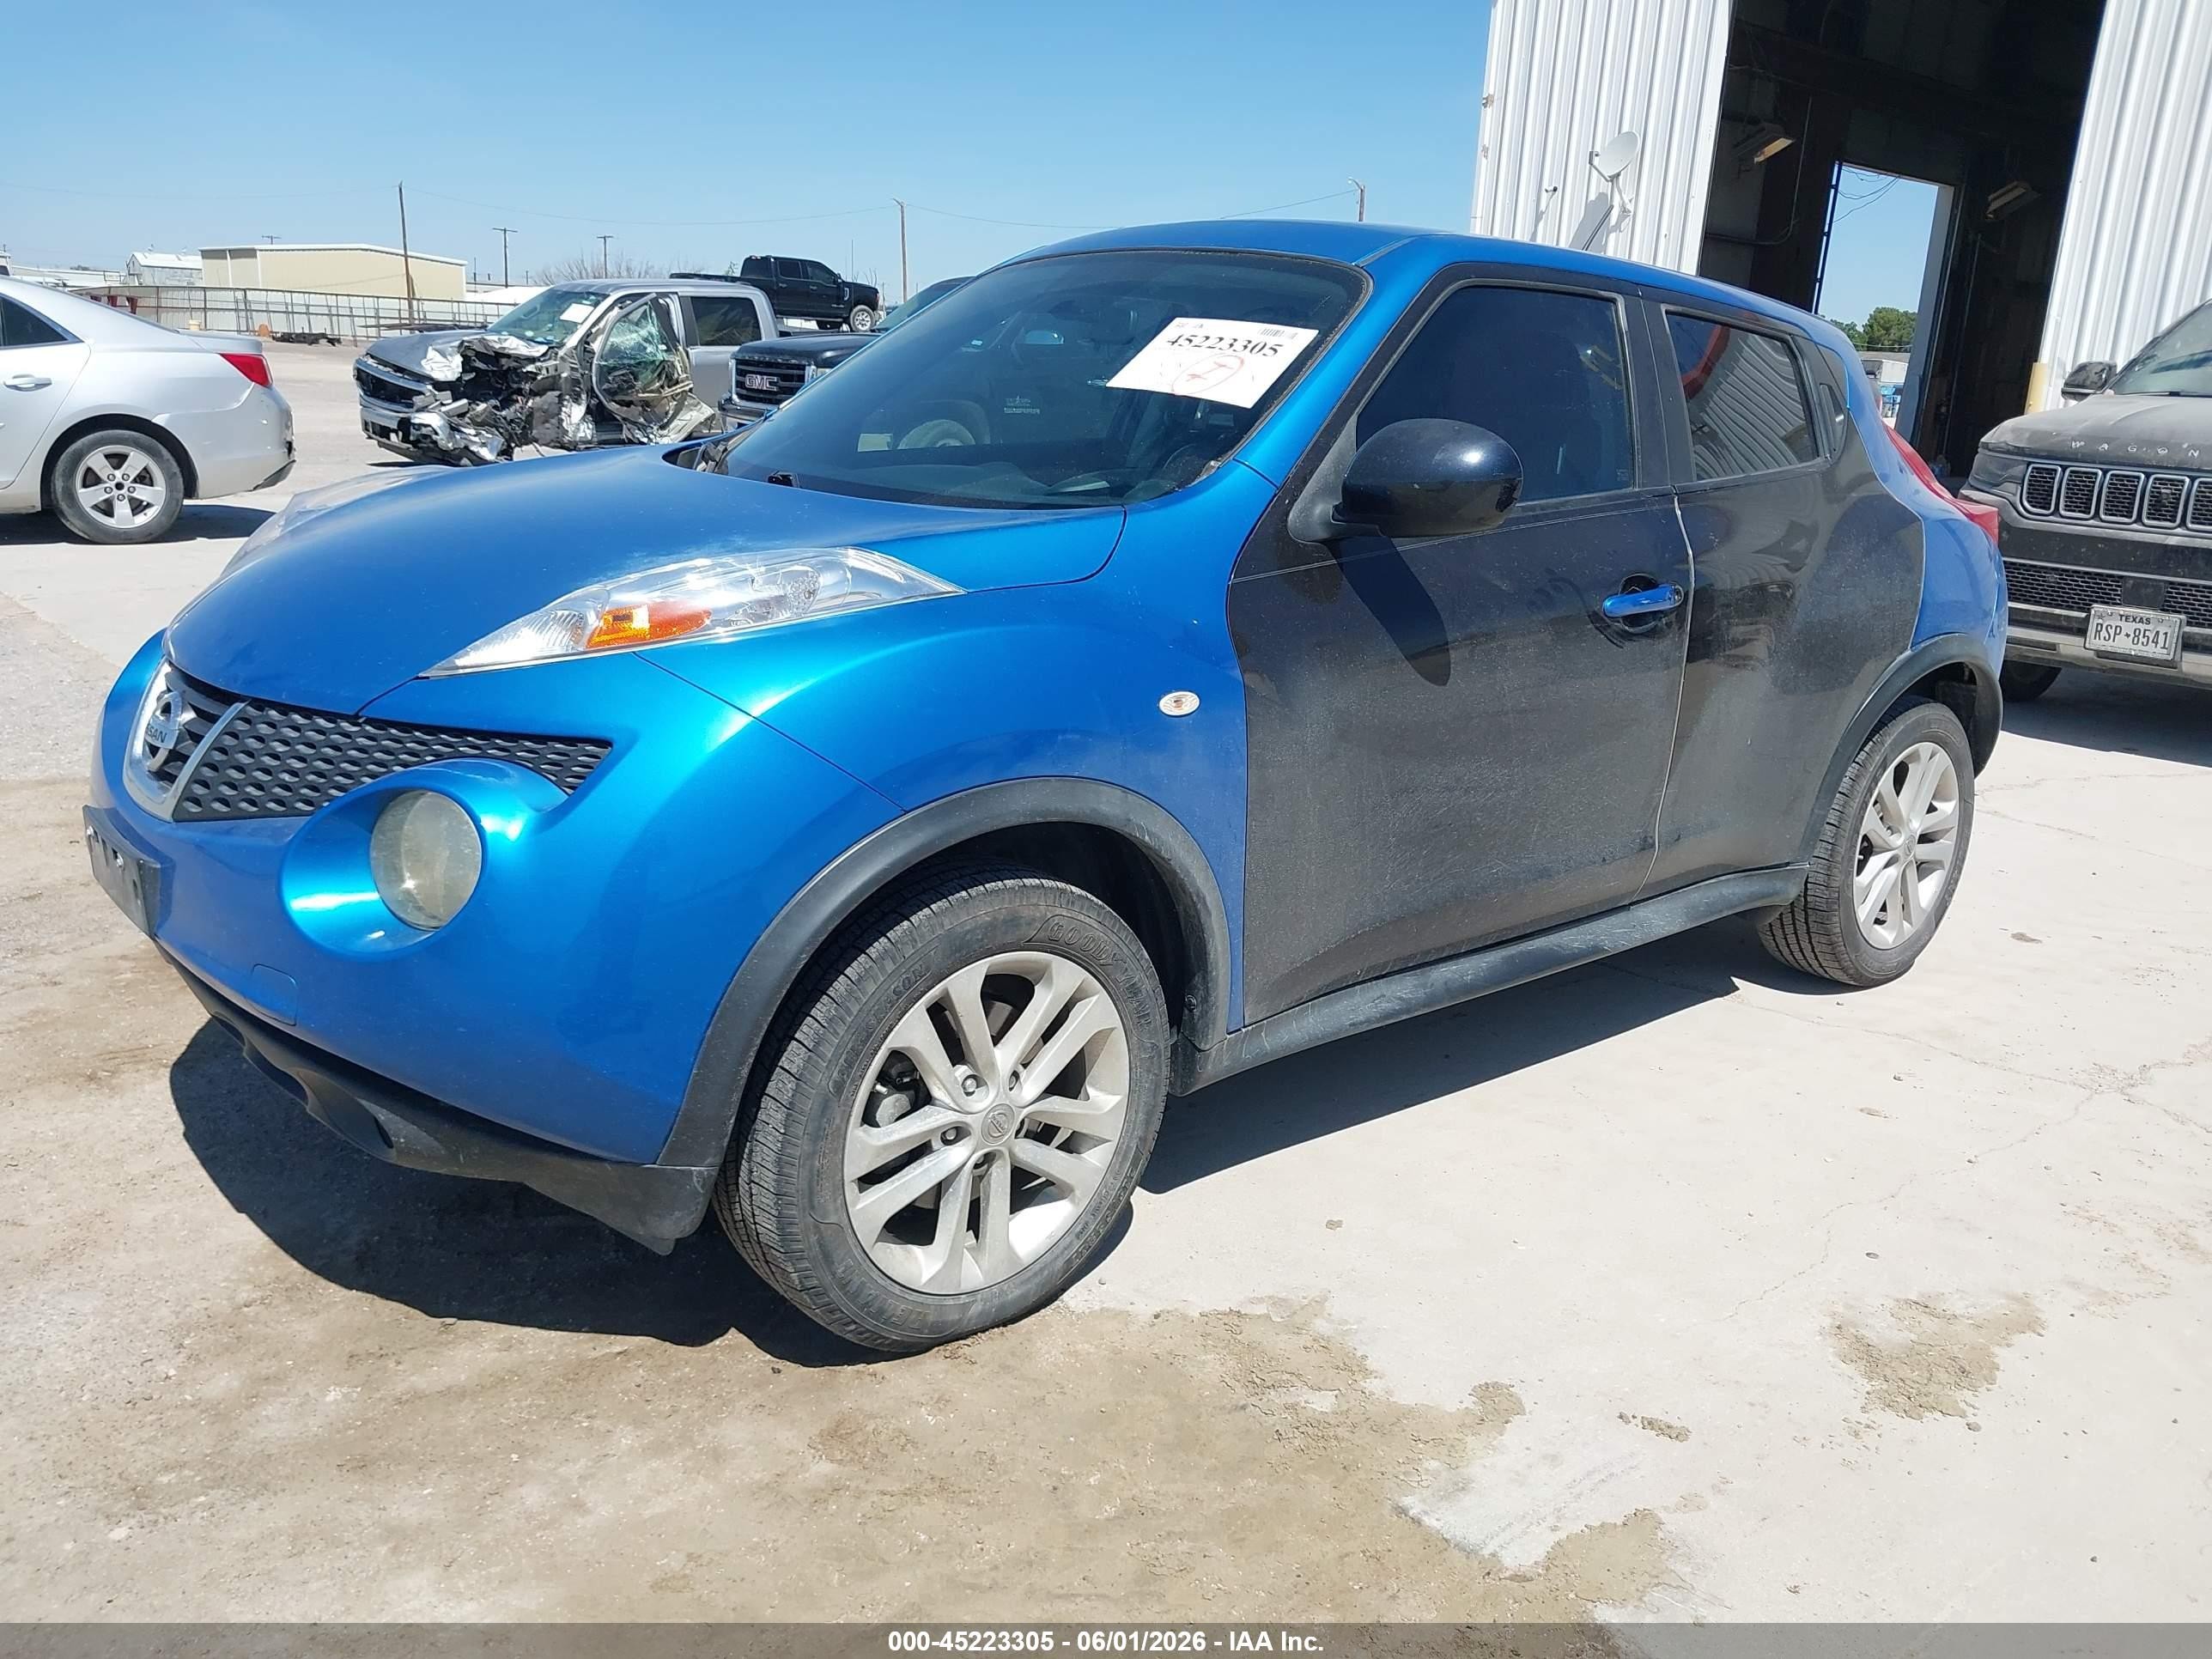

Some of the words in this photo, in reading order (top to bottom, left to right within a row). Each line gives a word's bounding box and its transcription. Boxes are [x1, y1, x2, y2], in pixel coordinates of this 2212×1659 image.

[1167, 333, 1283, 357] 45223305
[745, 374, 777, 392] GMC
[2118, 614, 2151, 625] TEXAS
